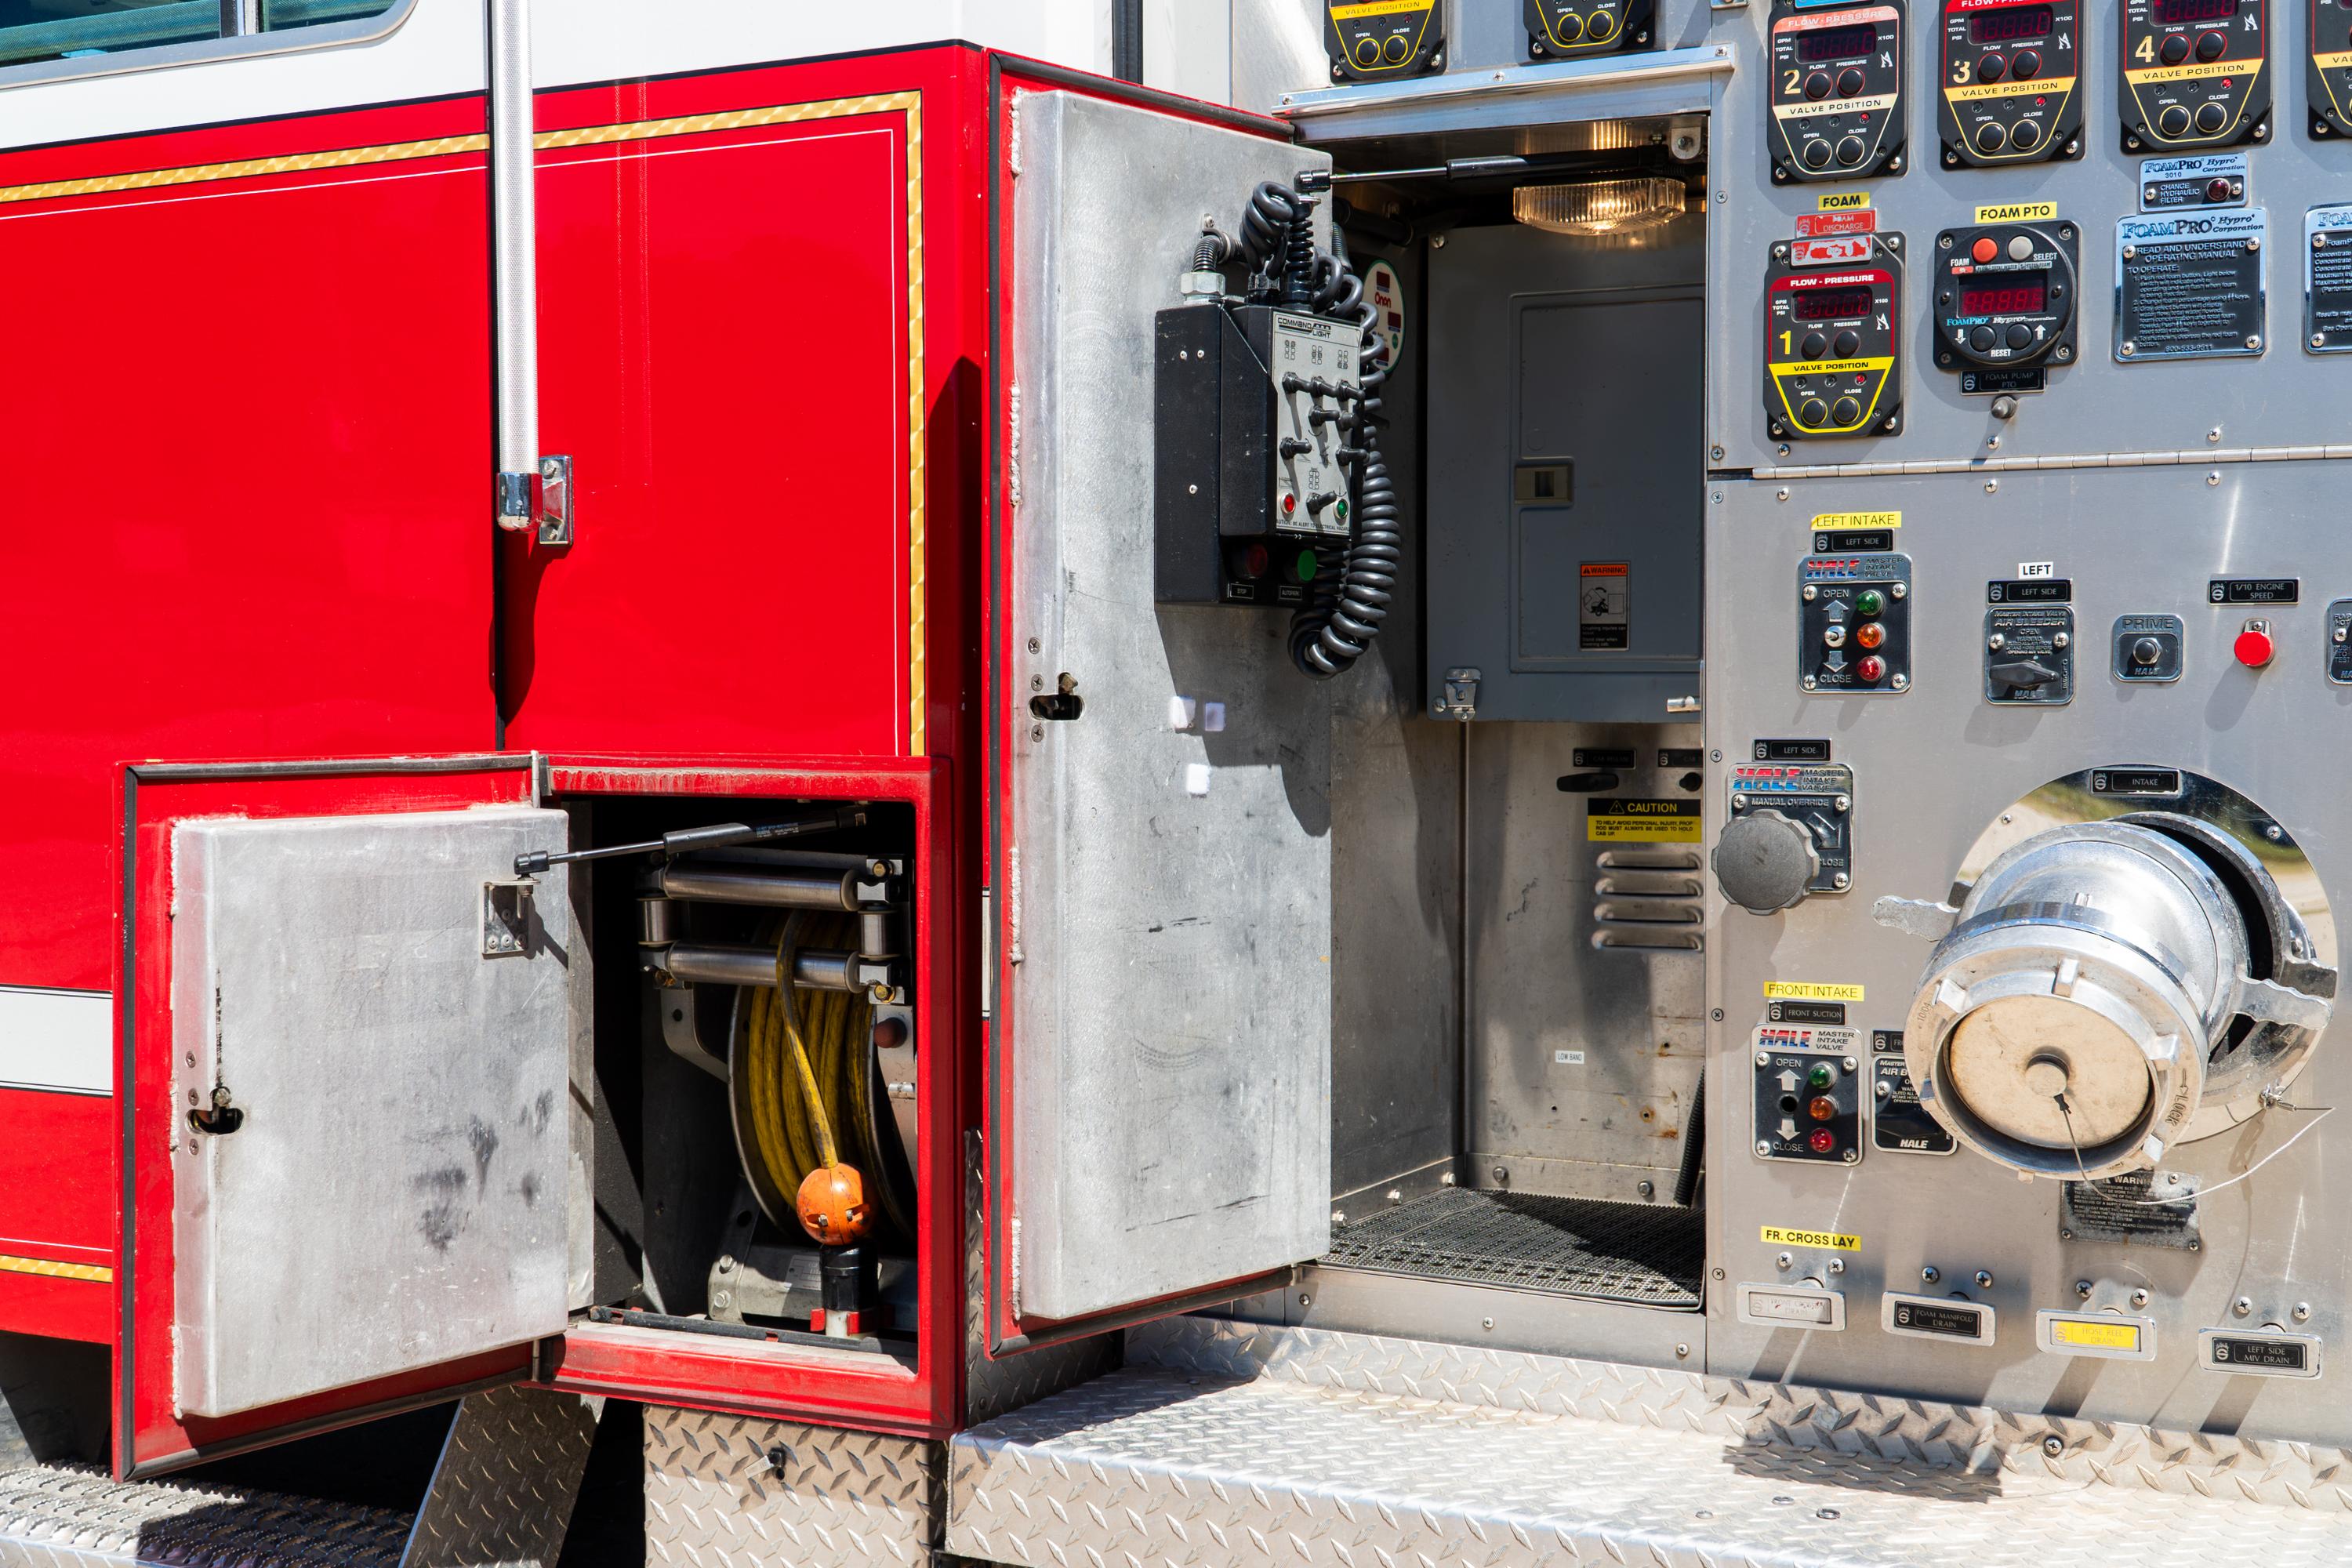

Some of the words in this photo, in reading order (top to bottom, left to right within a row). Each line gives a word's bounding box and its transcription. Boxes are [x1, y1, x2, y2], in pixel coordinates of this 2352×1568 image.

[1376, 2, 1420, 12] POSITION
[1788, 18, 1819, 27] FLOW
[2135, 35, 2154, 63] 4
[1953, 60, 1970, 84] 3
[2143, 71, 2181, 79] VALVE
[2187, 64, 2245, 76] POSITION
[1784, 69, 1801, 95] 2
[1962, 87, 1998, 96] VALVE
[2003, 82, 2058, 93] POSITION
[1790, 104, 1824, 114] VALVE
[1829, 100, 1882, 111] POSITION
[2160, 188, 2200, 198] HYDRAULIC
[1823, 194, 1861, 208] FOAM
[1980, 208, 2020, 220] FOAM
[2024, 205, 2050, 217] PTO
[1823, 222, 1864, 232] DISCHARGE
[2212, 223, 2263, 233] Corporation
[2137, 245, 2162, 254] READ
[2164, 244, 2183, 252] AND
[2184, 240, 2245, 251] UNDERSTAND
[2034, 252, 2057, 261] SELECT
[2145, 252, 2195, 263] OPERATING
[2198, 250, 2238, 260] MANUAL
[1951, 258, 1969, 267] FOAM
[1791, 278, 1817, 287] FLOW
[1824, 274, 1874, 285] PRESSURE
[1312, 330, 1331, 339] LIGHT
[1779, 330, 1791, 355] 1
[1991, 349, 2011, 358] RESET
[1826, 361, 1869, 370] POSITION
[1817, 516, 1846, 527] LEFT
[1849, 514, 1894, 525] INTAKE
[1806, 559, 1860, 579] HALE
[2023, 564, 2051, 575] LEFT
[1823, 590, 1849, 598] OPEN
[2122, 618, 2174, 630] PRIME
[2134, 667, 2160, 676] HALE
[1820, 674, 1852, 684] CLOSE
[1733, 768, 1802, 791] HALE
[1751, 798, 1786, 807] MANUAL
[1628, 803, 1677, 813] CAUTION
[1769, 984, 1810, 996] FRONT
[1813, 985, 1858, 998] INTAKE
[1759, 1029, 1812, 1047] HALE
[1776, 1058, 1802, 1067] OPEN
[2165, 1094, 2189, 1126] LOCK
[1773, 1142, 1804, 1152] CLOSE
[1900, 1139, 1929, 1149] HALE
[1766, 1230, 1784, 1241] FR.
[1787, 1232, 1829, 1245] CROSS
[1832, 1236, 1855, 1247] LAY
[1938, 1312, 1973, 1323] MANIFOLD
[1933, 1319, 1957, 1328] DRAIN
[2082, 1327, 2103, 1336] HOSE
[2090, 1336, 2115, 1345] DRAIN
[2248, 1345, 2264, 1354] LEFT
[2244, 1354, 2261, 1363] MIV
[2263, 1356, 2290, 1364] DRAIN
